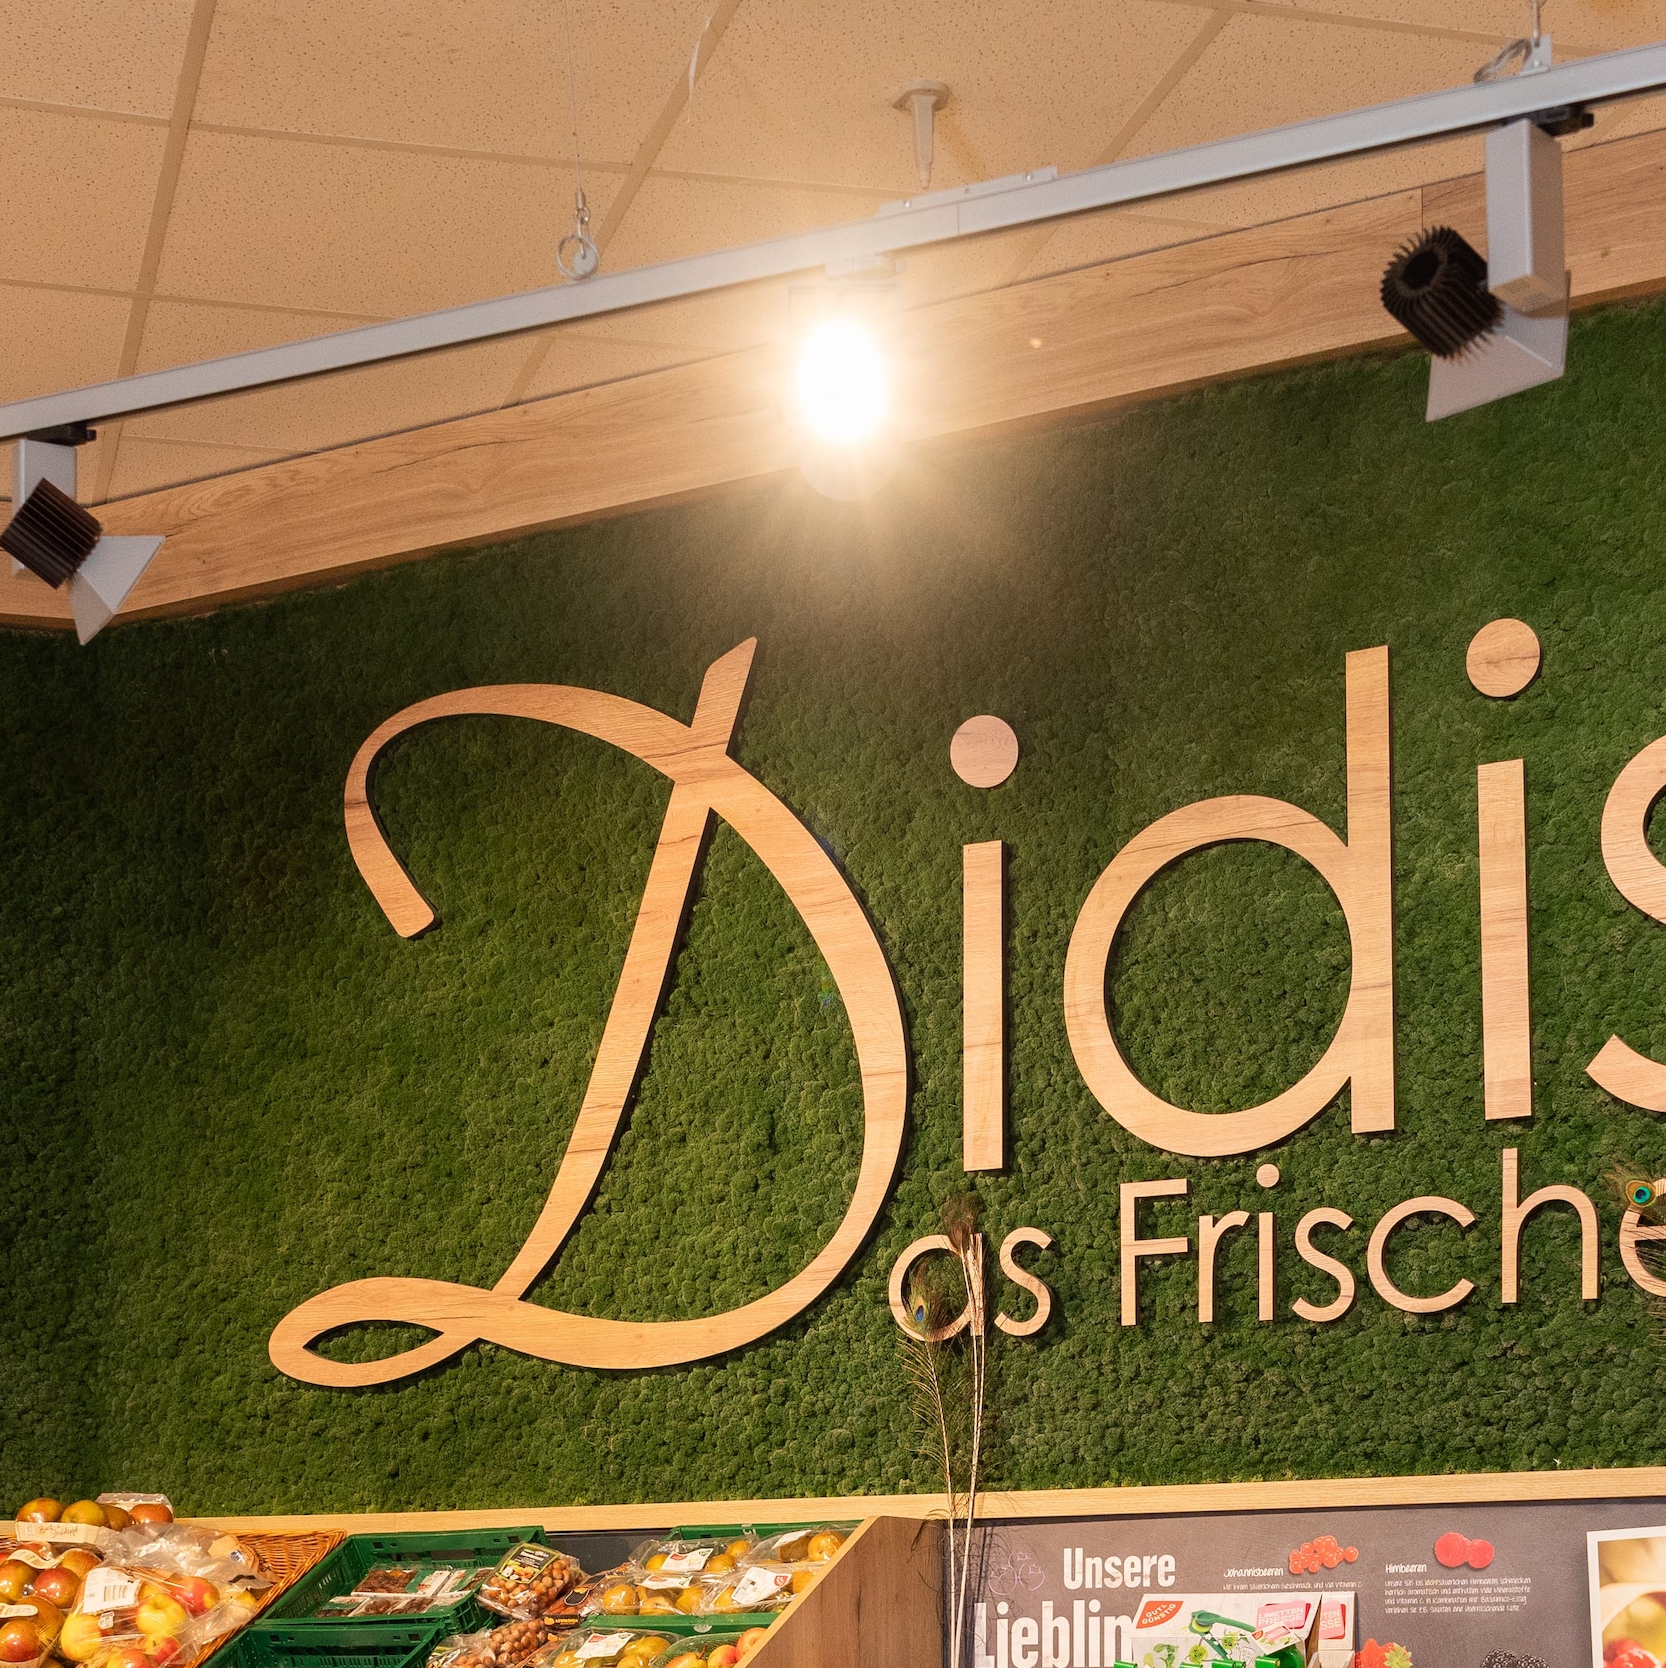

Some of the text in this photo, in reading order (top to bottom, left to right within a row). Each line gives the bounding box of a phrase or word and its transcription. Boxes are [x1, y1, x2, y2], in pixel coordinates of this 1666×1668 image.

[1063, 1547, 1176, 1590] Unsere
[1223, 1567, 1284, 1578] Johannisbeeren
[1385, 1564, 1427, 1573] Himbeeren
[1500, 1577, 1531, 1585] schmecken
[1141, 1603, 1177, 1625] GÜNSTIG
[1145, 1606, 1160, 1618] GUT
[1258, 1607, 1304, 1620] LIMETTEN
[1258, 1613, 1303, 1627] PRESSE
[974, 1599, 1133, 1668] Lieblin
